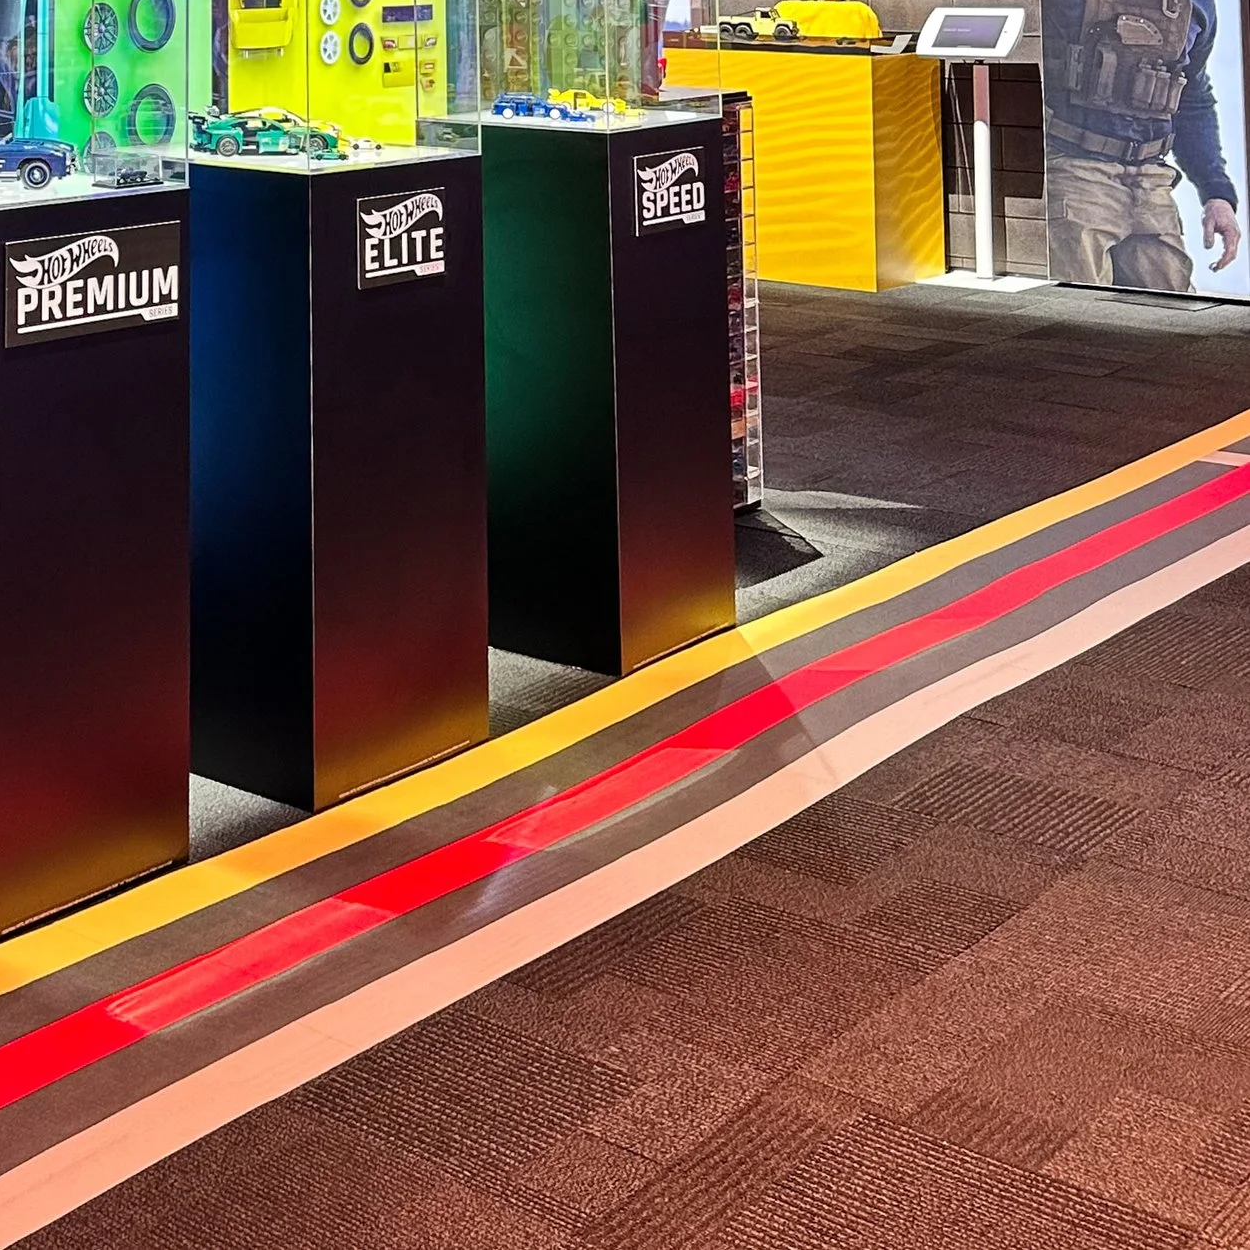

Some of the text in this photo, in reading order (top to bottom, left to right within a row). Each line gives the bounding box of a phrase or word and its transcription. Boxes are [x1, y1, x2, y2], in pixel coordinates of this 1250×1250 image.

[642, 181, 706, 219] SPEED
[365, 227, 444, 271] ELITE
[17, 264, 179, 326] PREMIUM
[149, 305, 173, 318] SERIES
